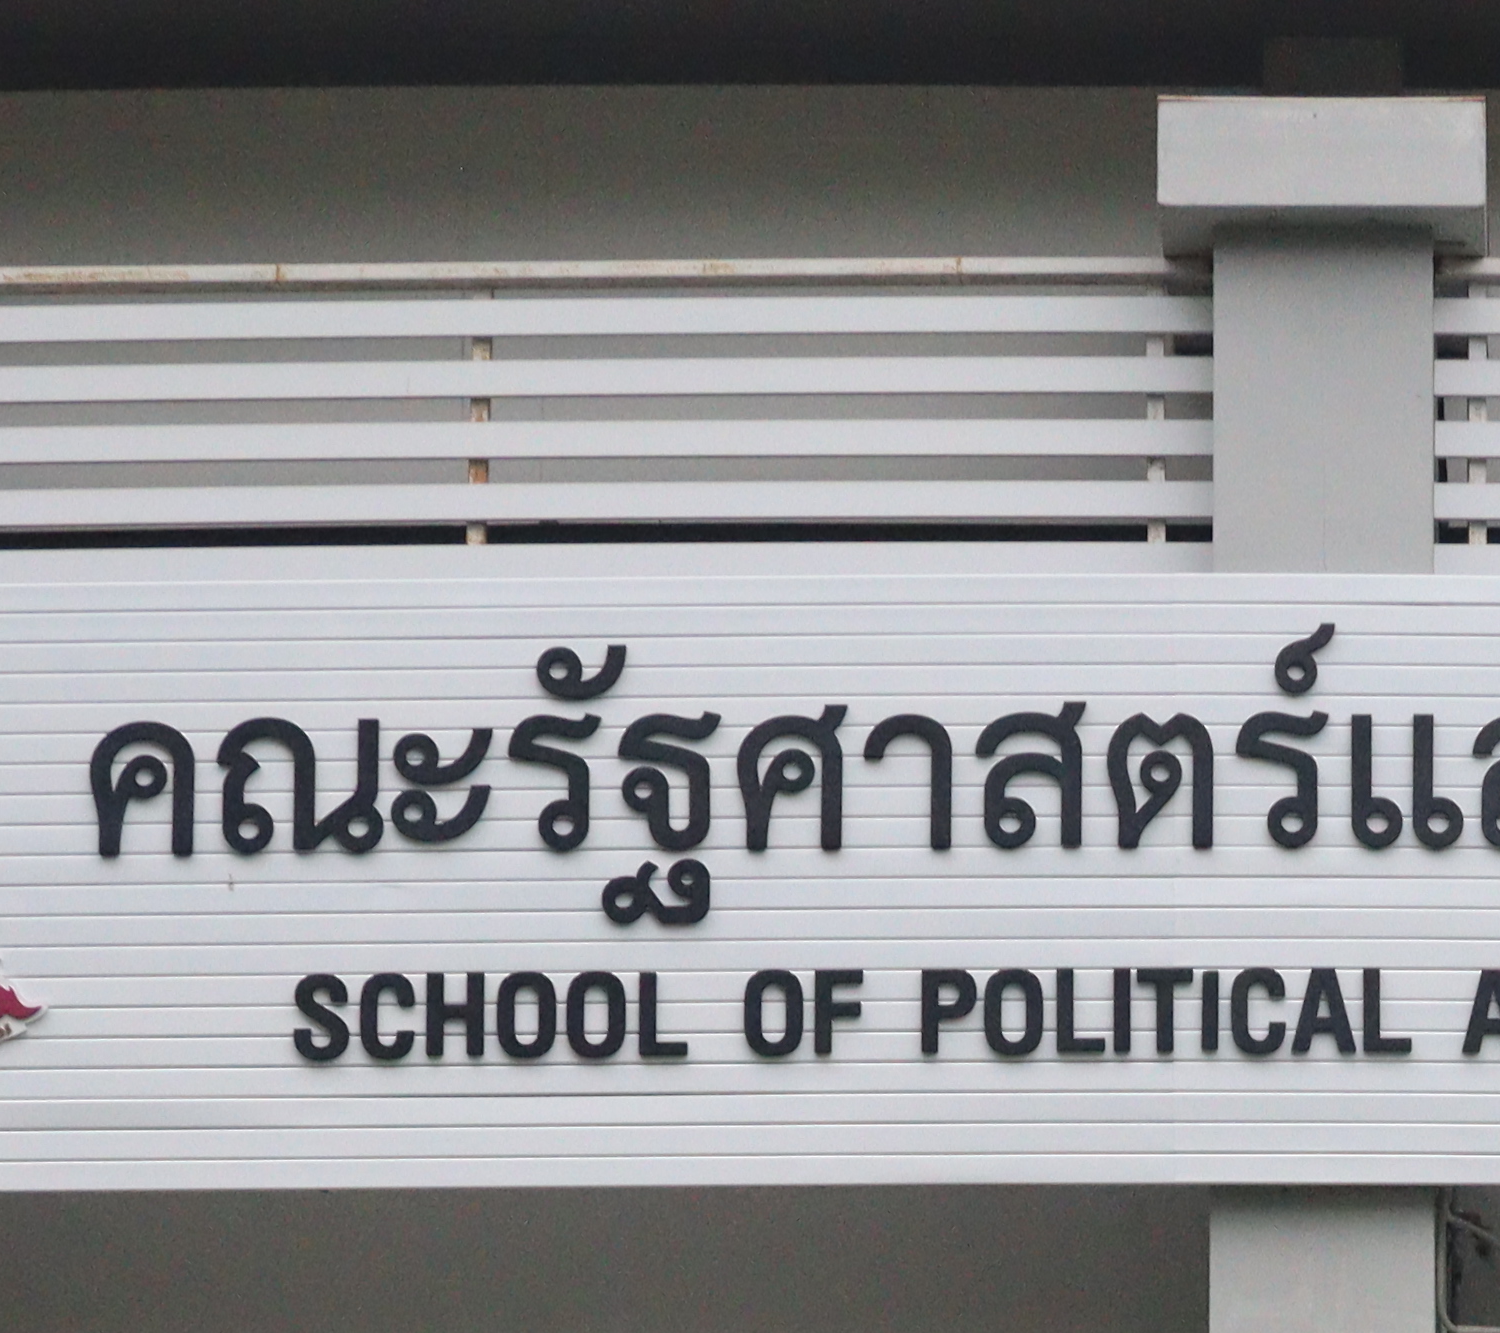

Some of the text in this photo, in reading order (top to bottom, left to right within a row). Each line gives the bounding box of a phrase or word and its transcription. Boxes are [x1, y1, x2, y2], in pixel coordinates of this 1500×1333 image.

[293, 971, 688, 1062] SCHOOL
[743, 969, 864, 1059] OF
[920, 967, 1412, 1060] POLITICAL
